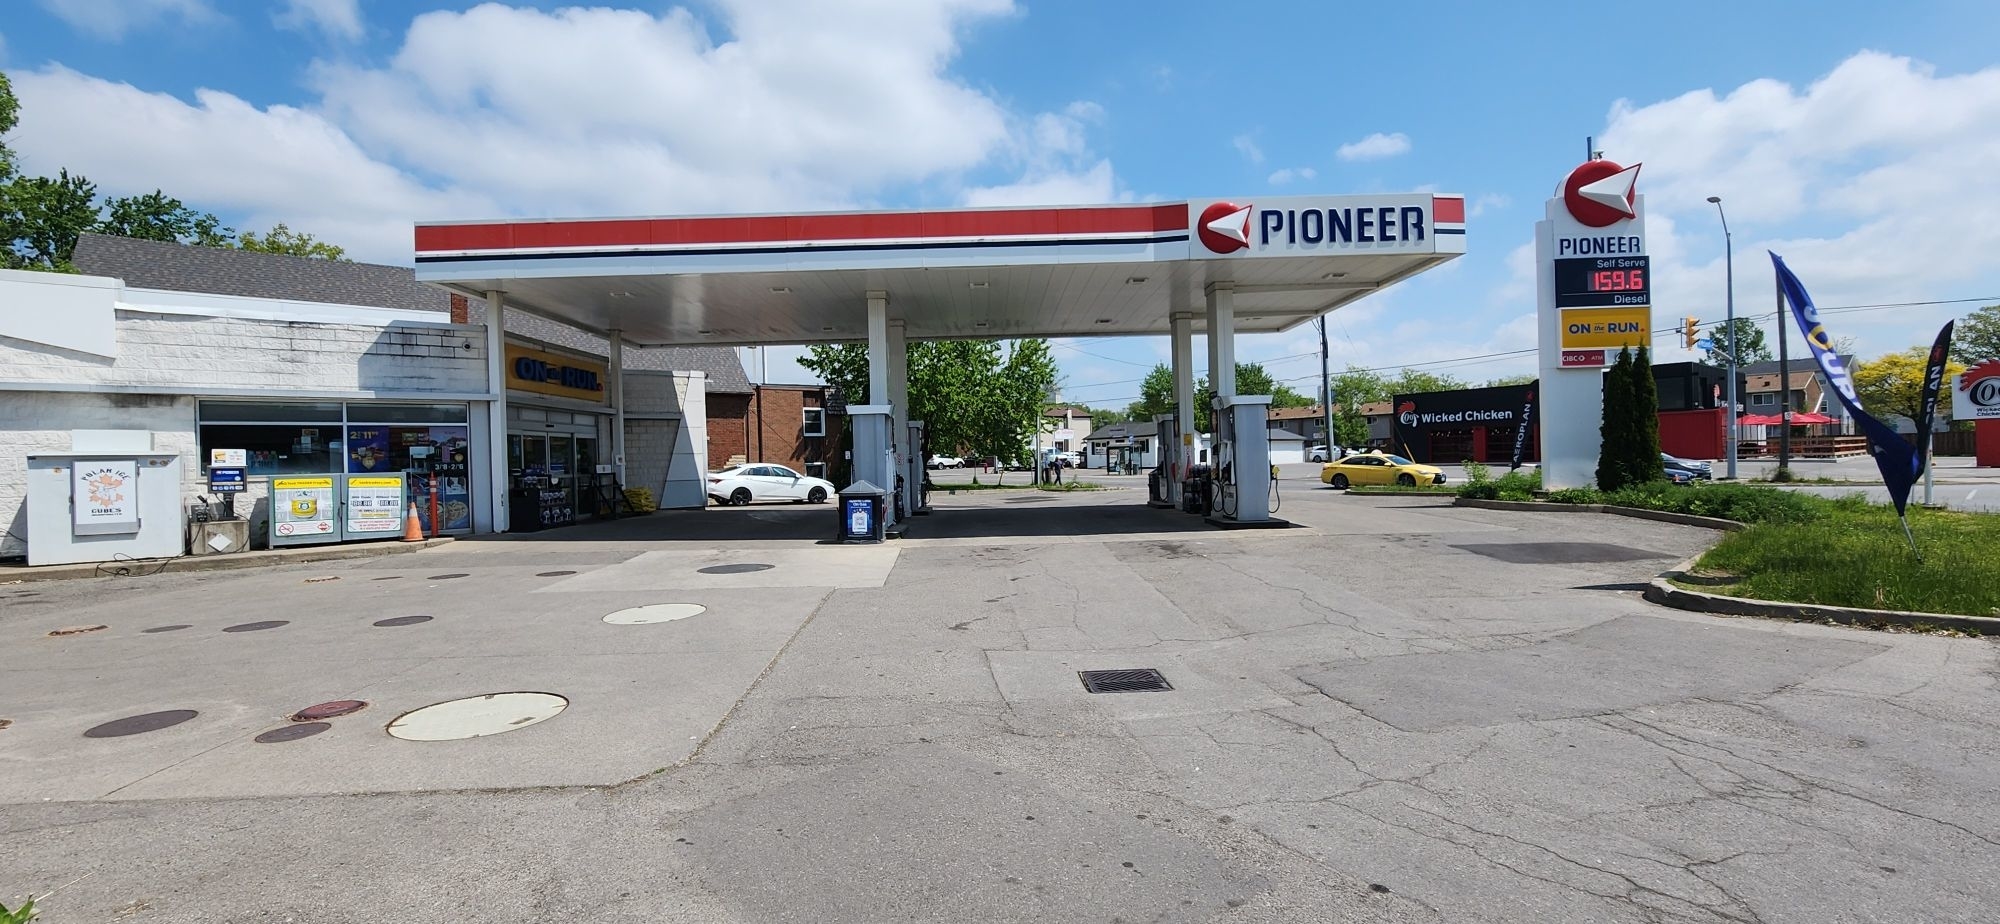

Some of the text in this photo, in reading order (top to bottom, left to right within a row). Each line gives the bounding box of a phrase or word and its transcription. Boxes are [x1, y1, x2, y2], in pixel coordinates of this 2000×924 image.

[1260, 206, 1425, 245] PIONEER
[1559, 236, 1641, 255] PIONEER
[1597, 259, 1645, 269] Self Serve
[1593, 270, 1643, 291] 159.6
[1614, 294, 1647, 304] Diesel
[1568, 323, 1591, 335] ON
[1594, 324, 1605, 332] the
[515, 358, 548, 383] ON
[1421, 411, 1462, 424] Wicked
[1465, 409, 1513, 421] Chicken
[1513, 403, 1532, 462] AEROPLAN
[115, 470, 131, 481] ICE
